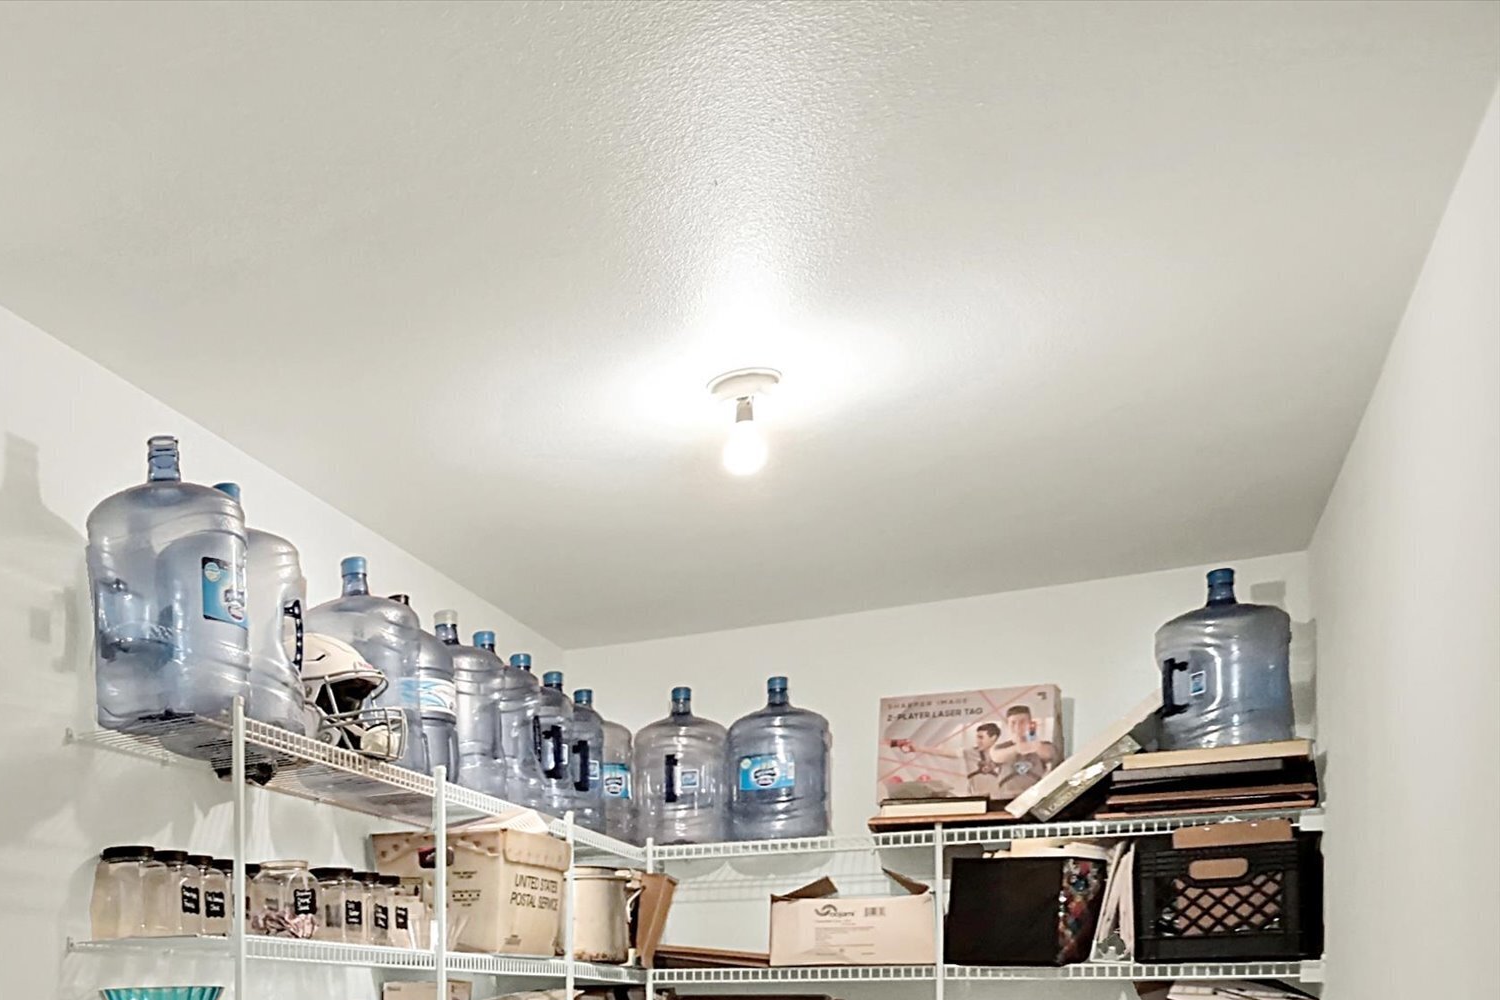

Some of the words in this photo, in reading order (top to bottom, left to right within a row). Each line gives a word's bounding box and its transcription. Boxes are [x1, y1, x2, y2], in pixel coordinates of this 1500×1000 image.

[887, 701, 933, 710] SHARPER
[937, 698, 968, 706] IMAGE
[886, 710, 932, 722] 2-PLAYER
[932, 708, 961, 719] LASER
[965, 707, 983, 716] TAG
[514, 873, 539, 890] UNITED
[540, 877, 558, 894] STATES
[509, 891, 536, 908] POSTAL
[538, 896, 558, 912] SERVICE
